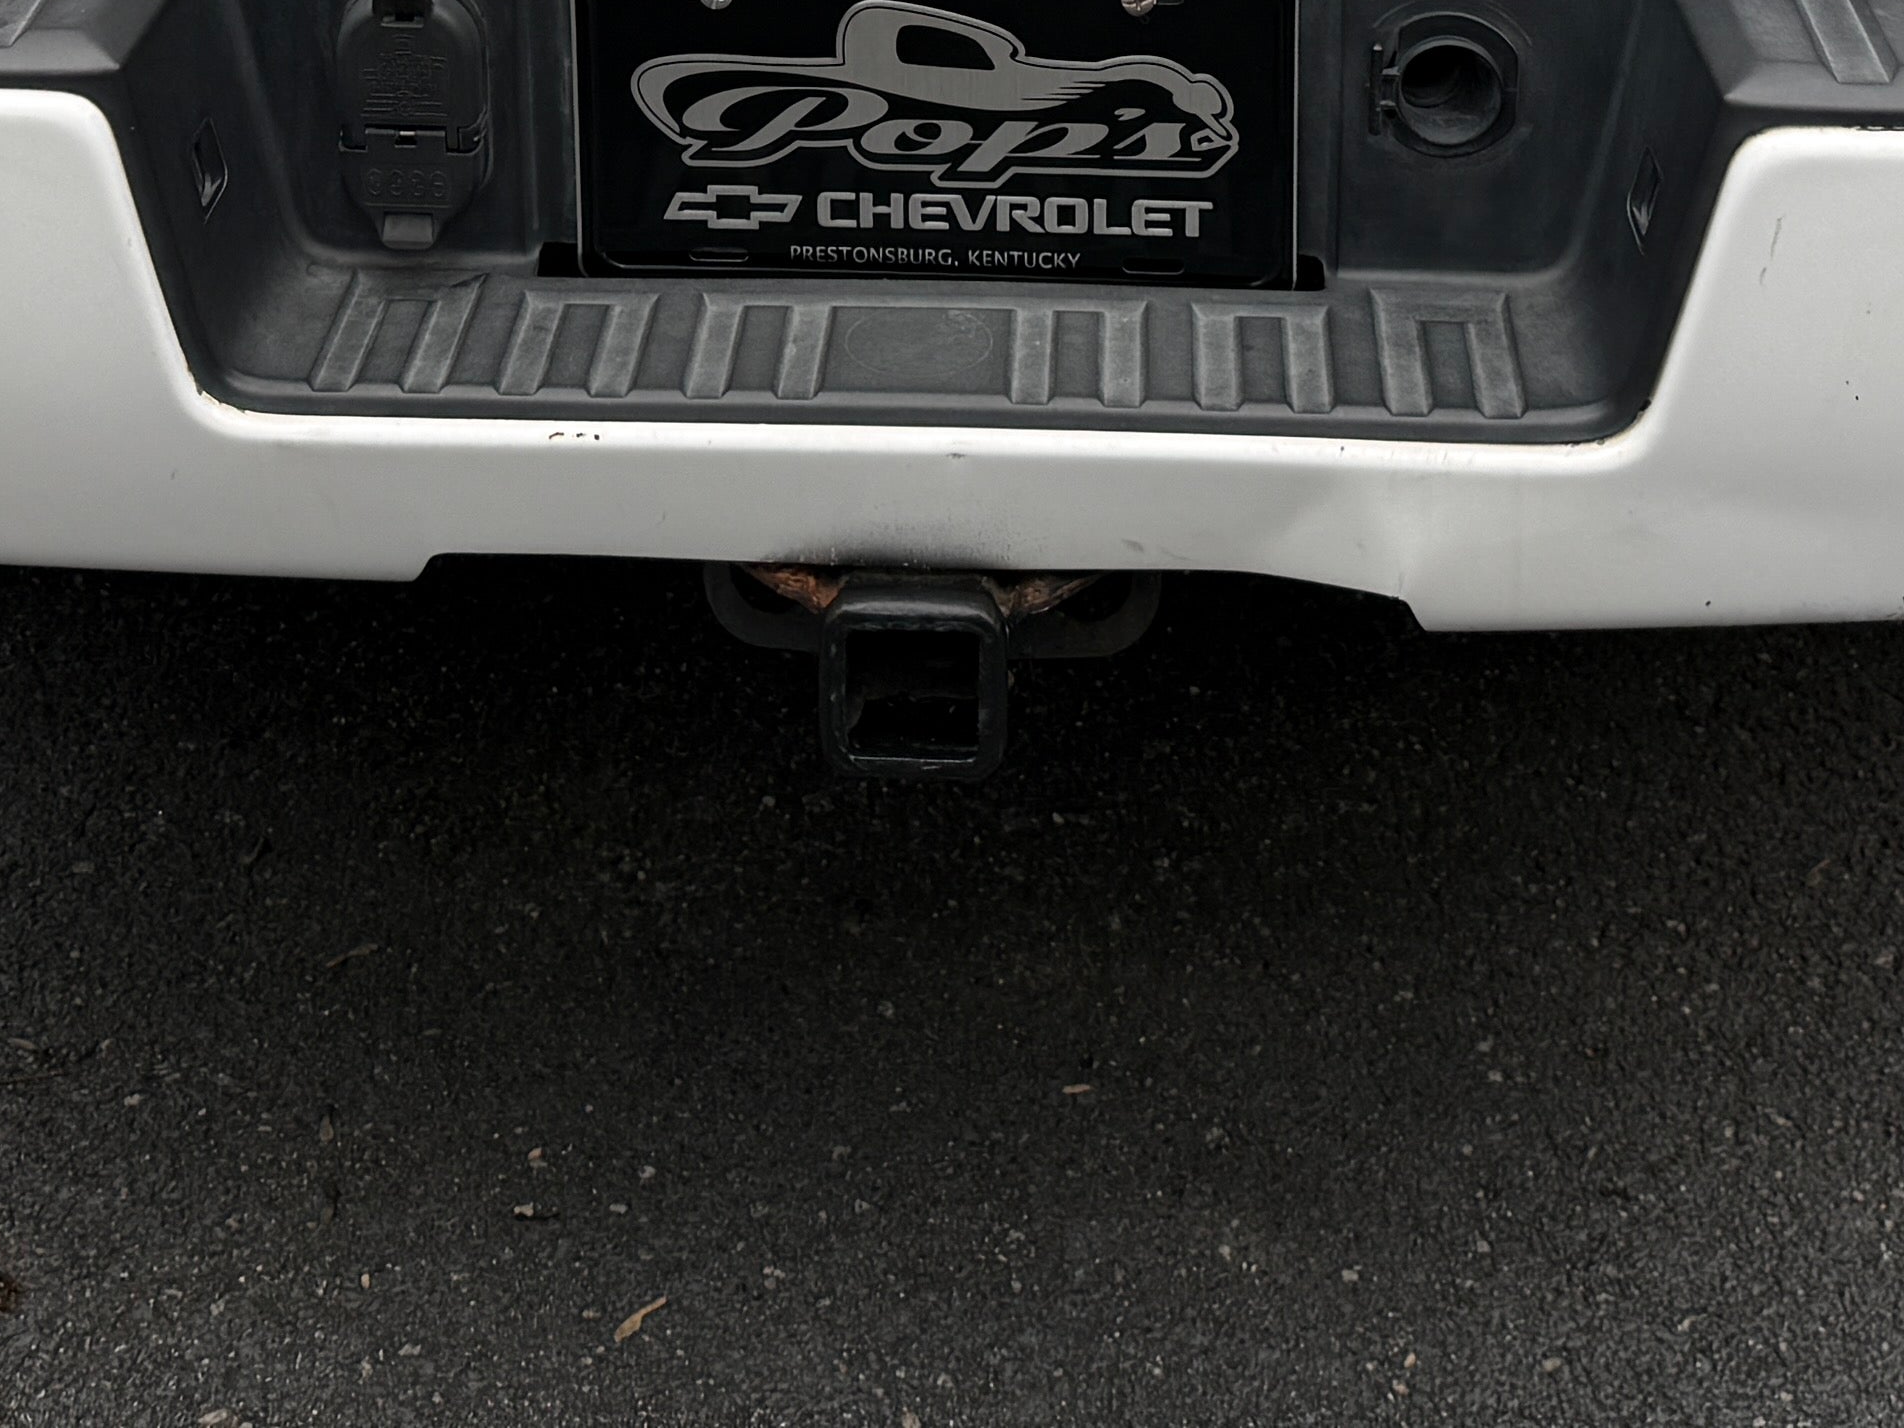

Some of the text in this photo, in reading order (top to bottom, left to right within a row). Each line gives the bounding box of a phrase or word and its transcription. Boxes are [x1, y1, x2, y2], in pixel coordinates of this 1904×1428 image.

[680, 84, 1202, 176] Pop's
[815, 190, 1214, 238] CHEVROLET
[789, 244, 1082, 271] PRESTONSBURG, KENTUCKY
